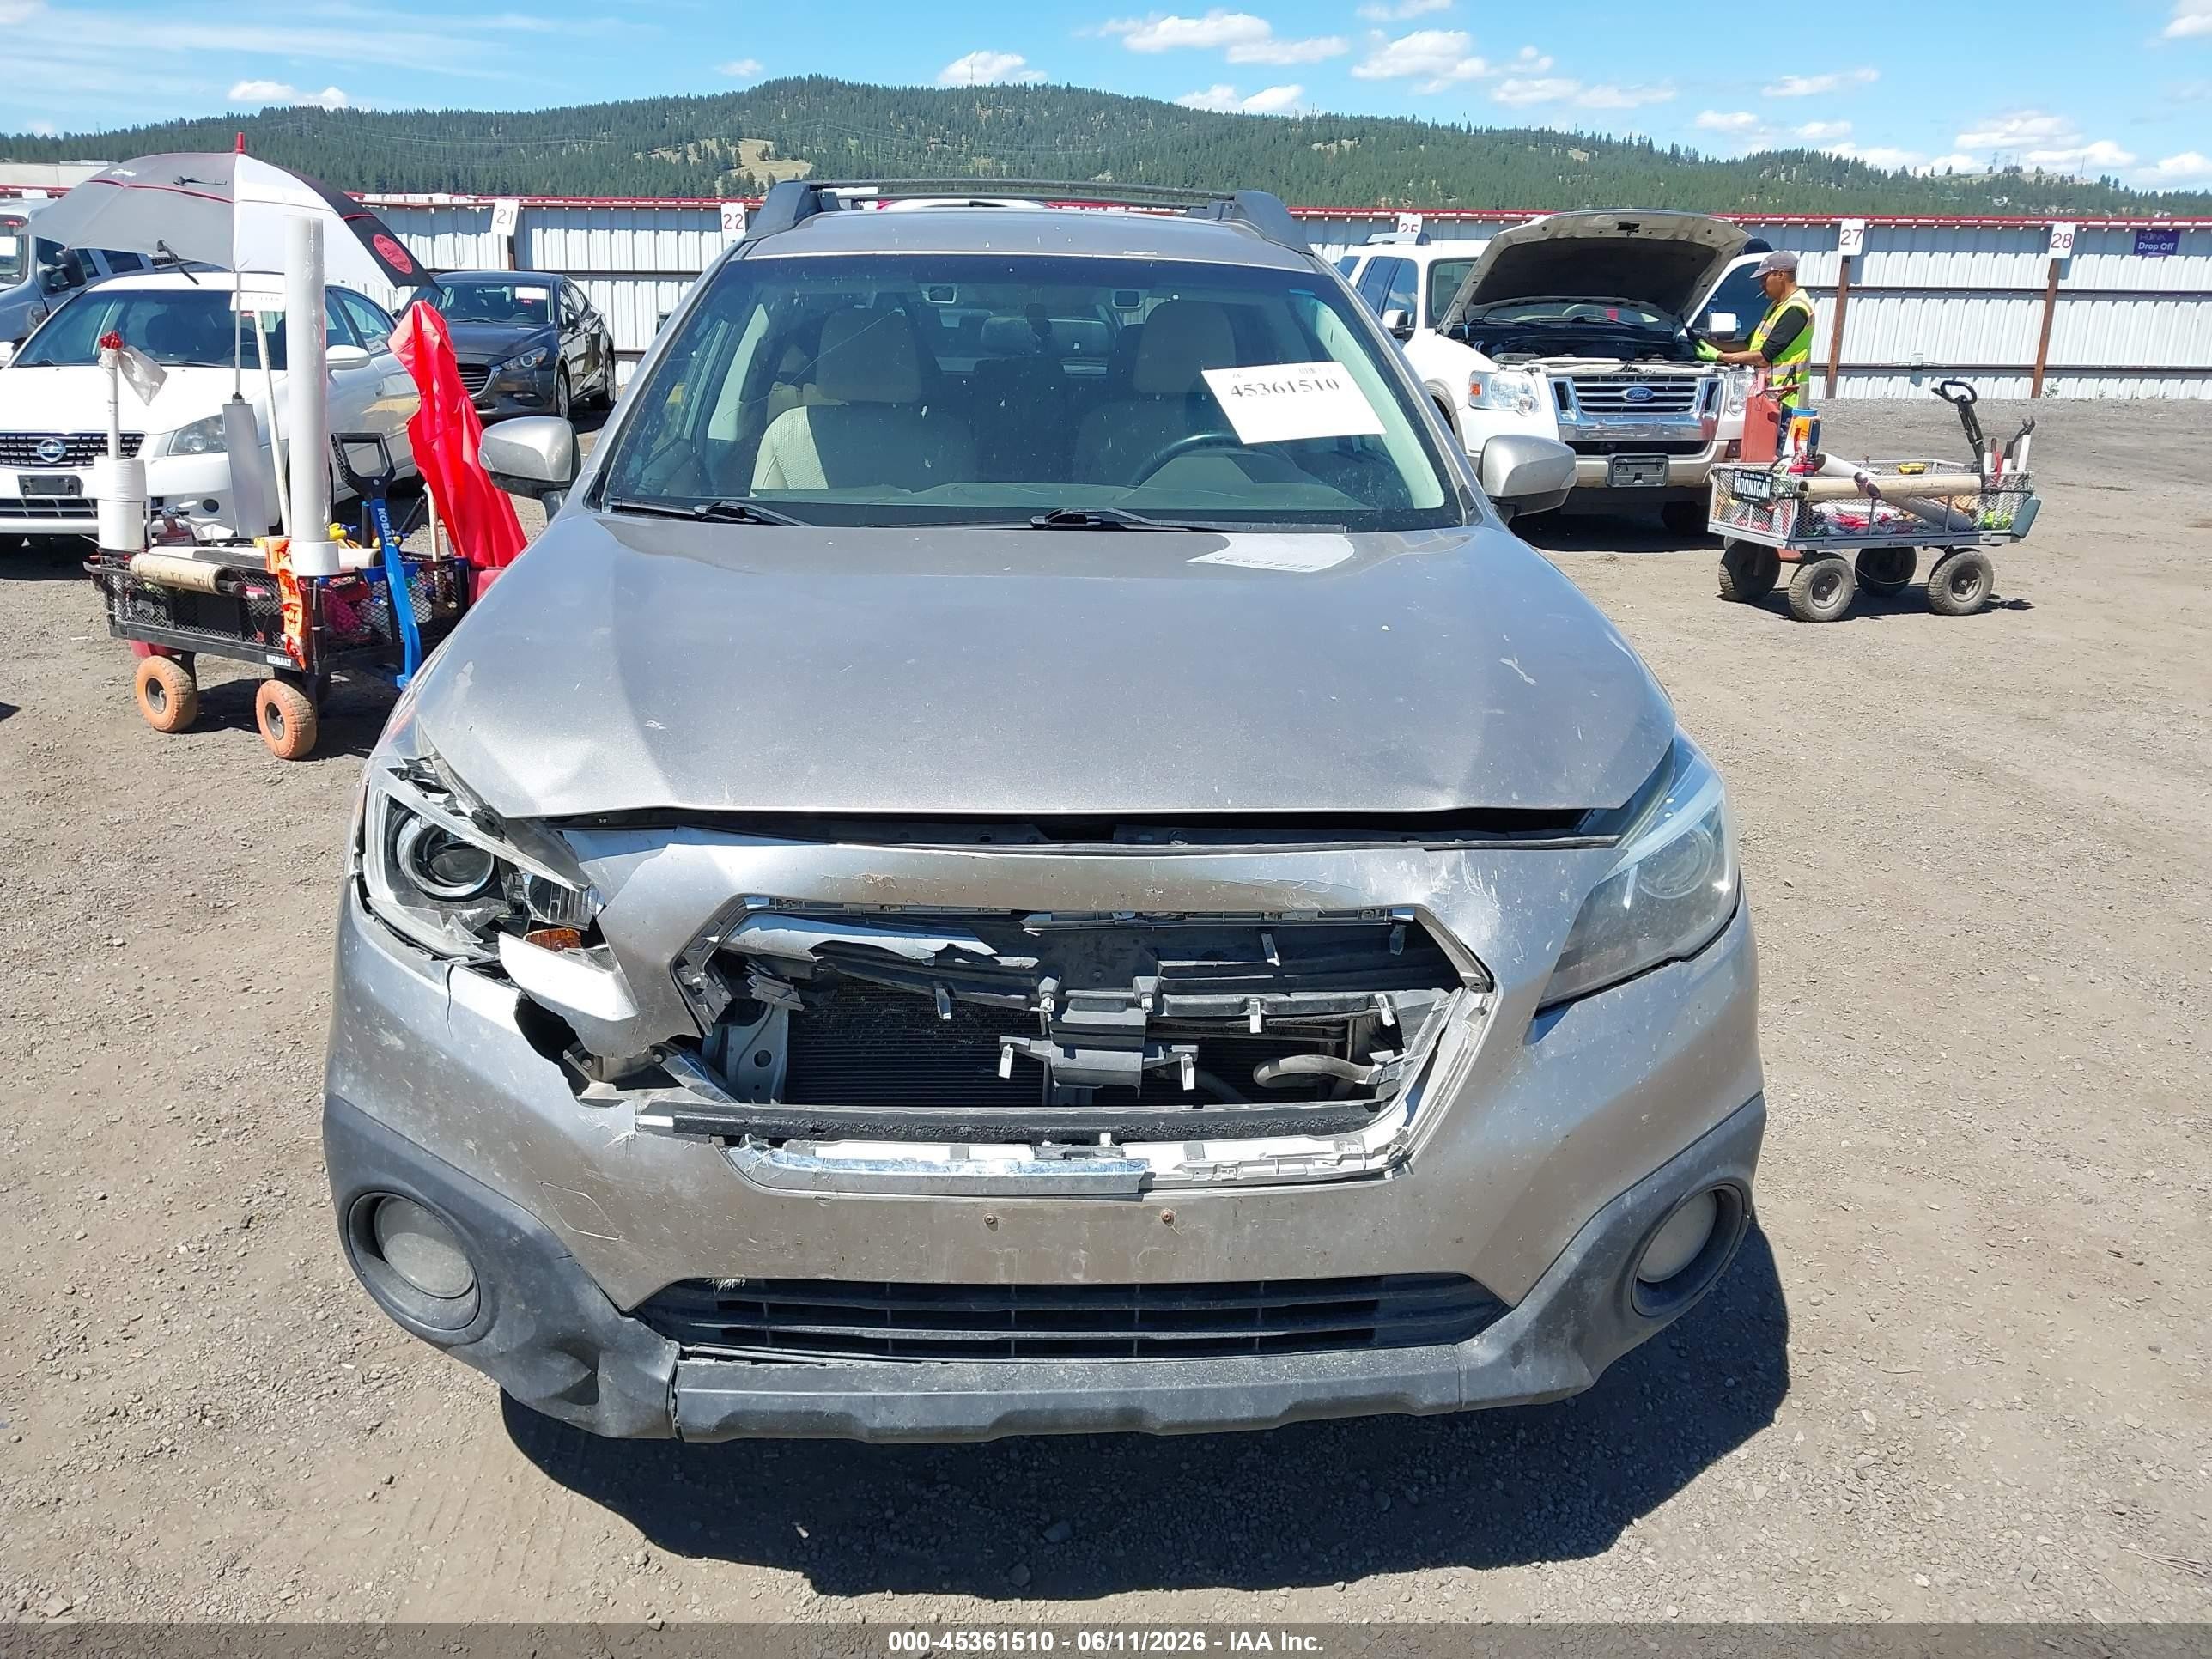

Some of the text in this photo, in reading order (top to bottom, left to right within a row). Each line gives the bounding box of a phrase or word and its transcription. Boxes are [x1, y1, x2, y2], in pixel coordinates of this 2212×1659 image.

[496, 208, 514, 225] 21
[723, 213, 744, 229] 22
[1401, 222, 1419, 233] 25
[1840, 228, 1863, 246] 27
[2050, 232, 2073, 249] 28
[2138, 241, 2175, 252] Drop Off
[1230, 378, 1340, 398] 45361510
[1631, 390, 1649, 398] Ford
[377, 507, 396, 548] KOBALT
